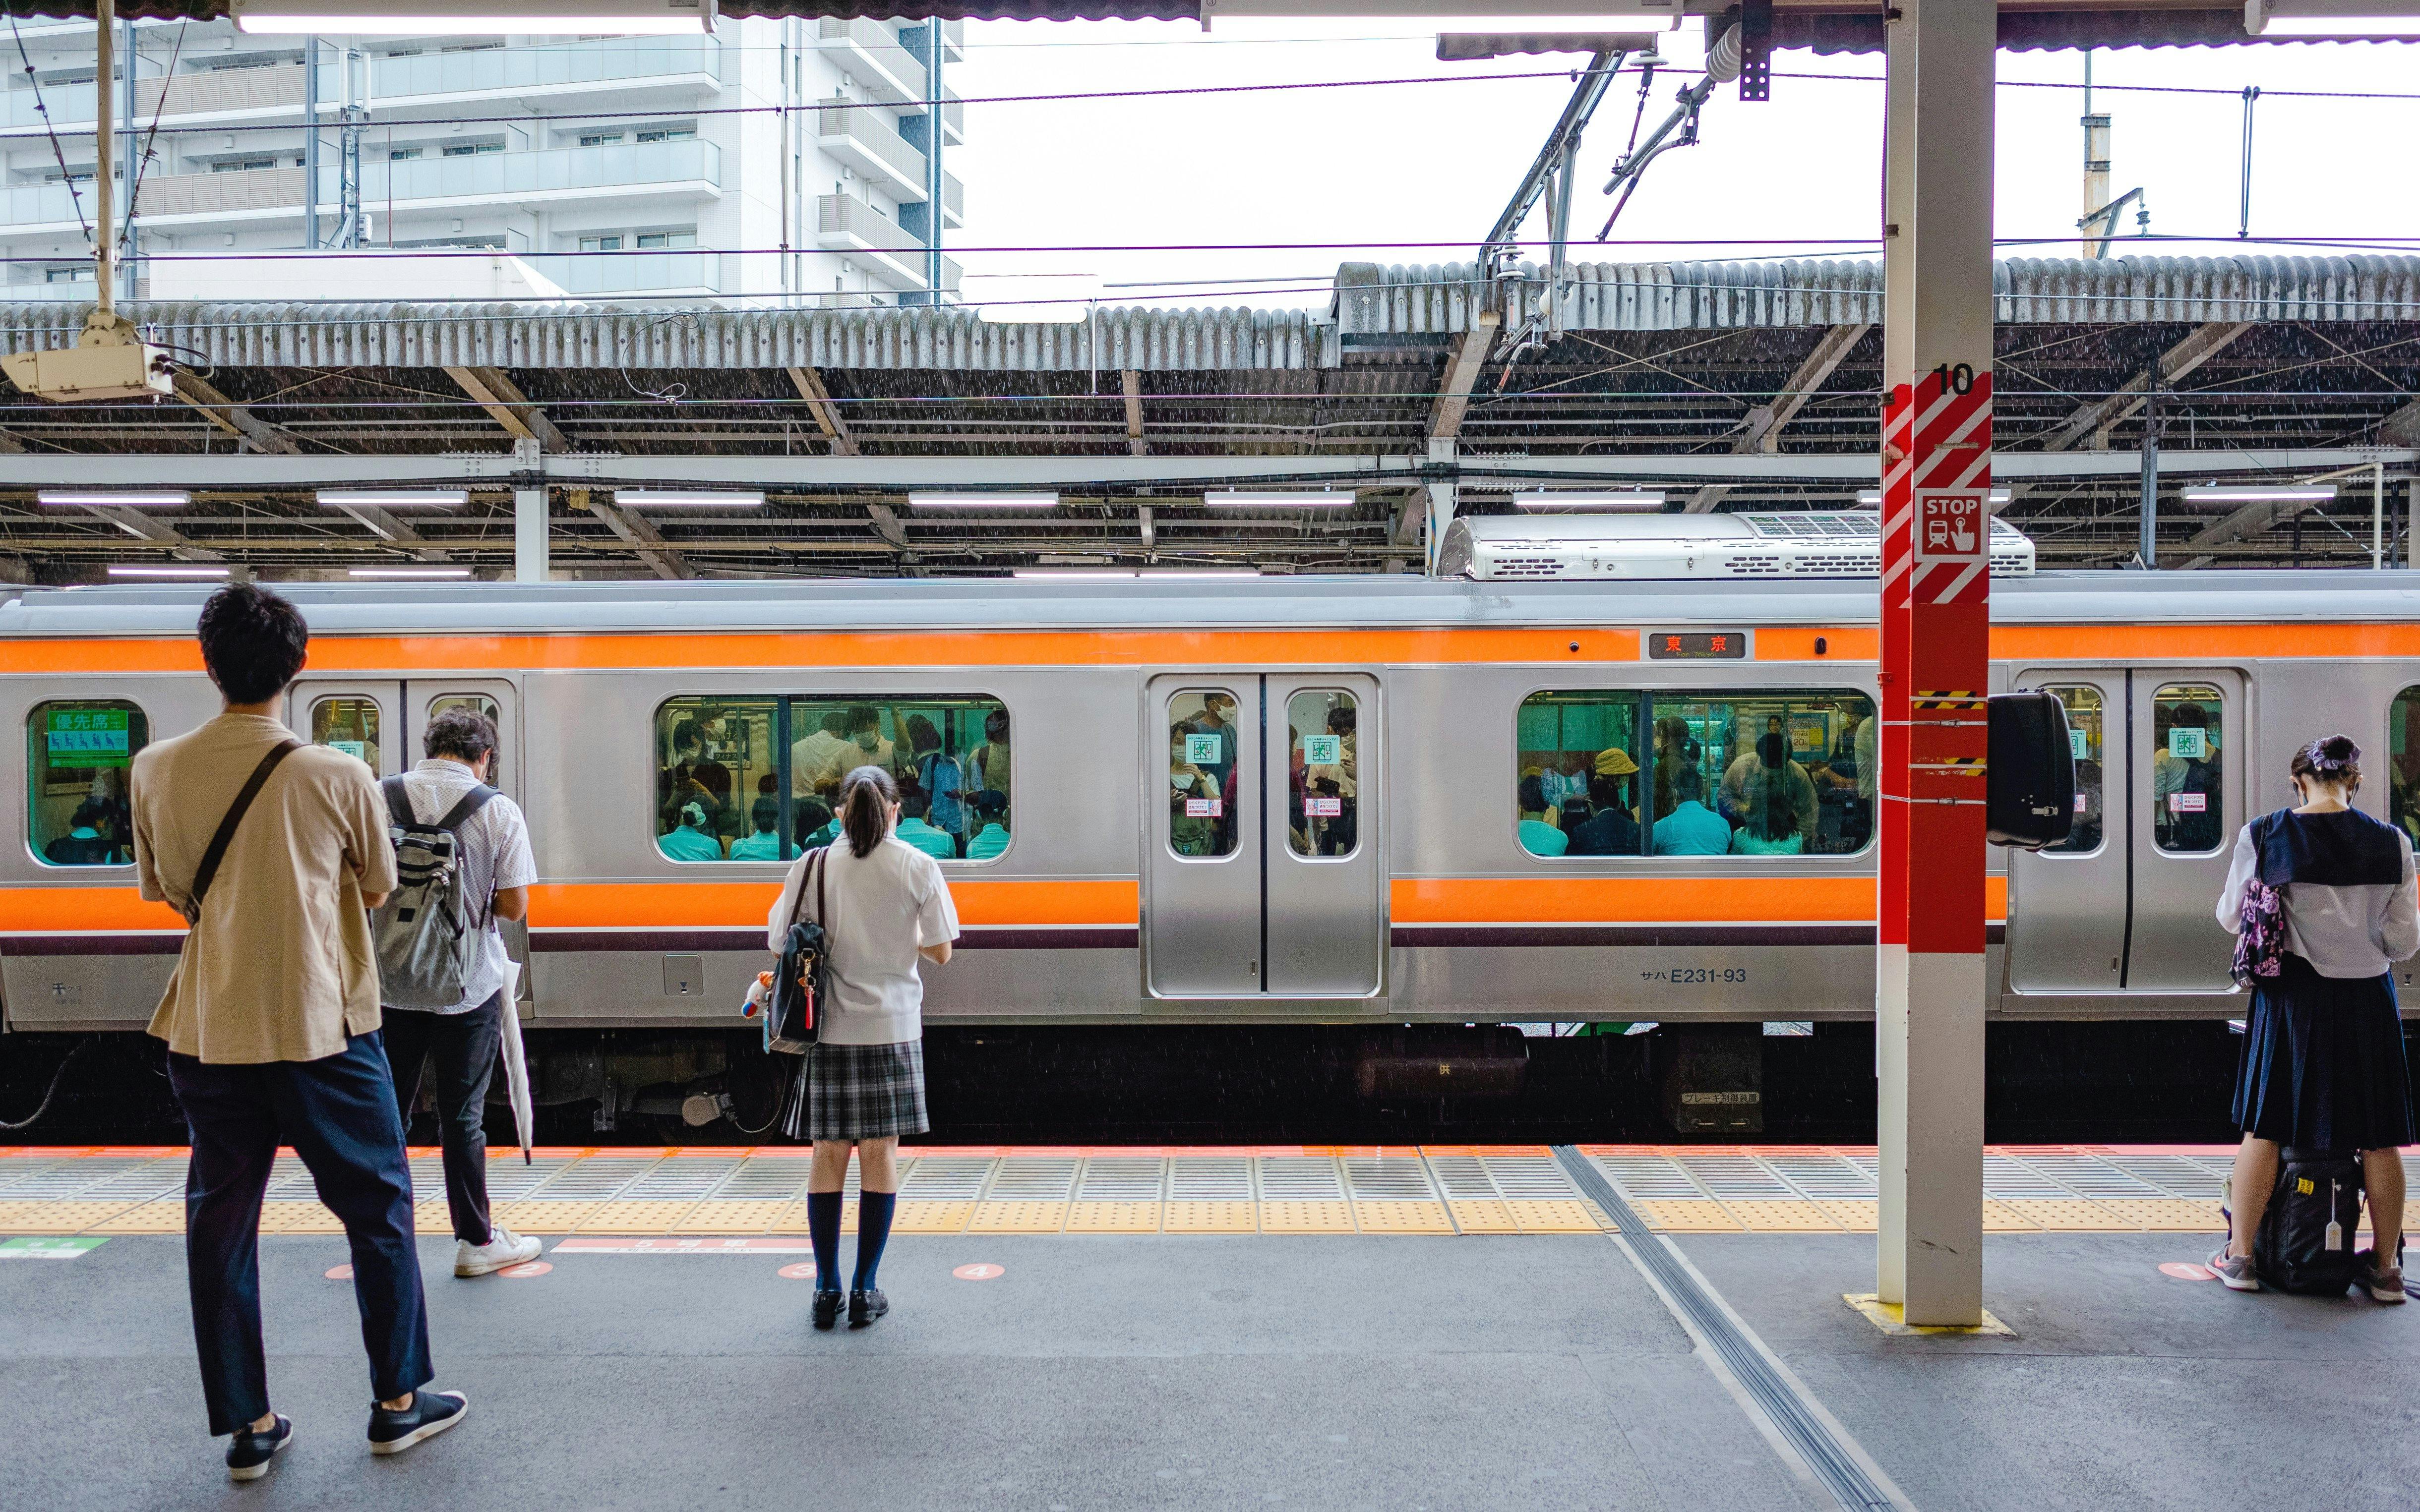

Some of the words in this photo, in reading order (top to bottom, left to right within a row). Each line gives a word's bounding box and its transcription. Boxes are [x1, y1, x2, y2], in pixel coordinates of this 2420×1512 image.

[1934, 363, 1974, 396] 10
[1927, 499, 1977, 514] STOP
[1666, 635, 1726, 652] 東京
[56, 714, 108, 730] 優先席
[1685, 1094, 1756, 1103] ブレーキ制御装置
[509, 1264, 540, 1275] 2
[791, 1265, 815, 1276] 3
[965, 1266, 988, 1277] 4
